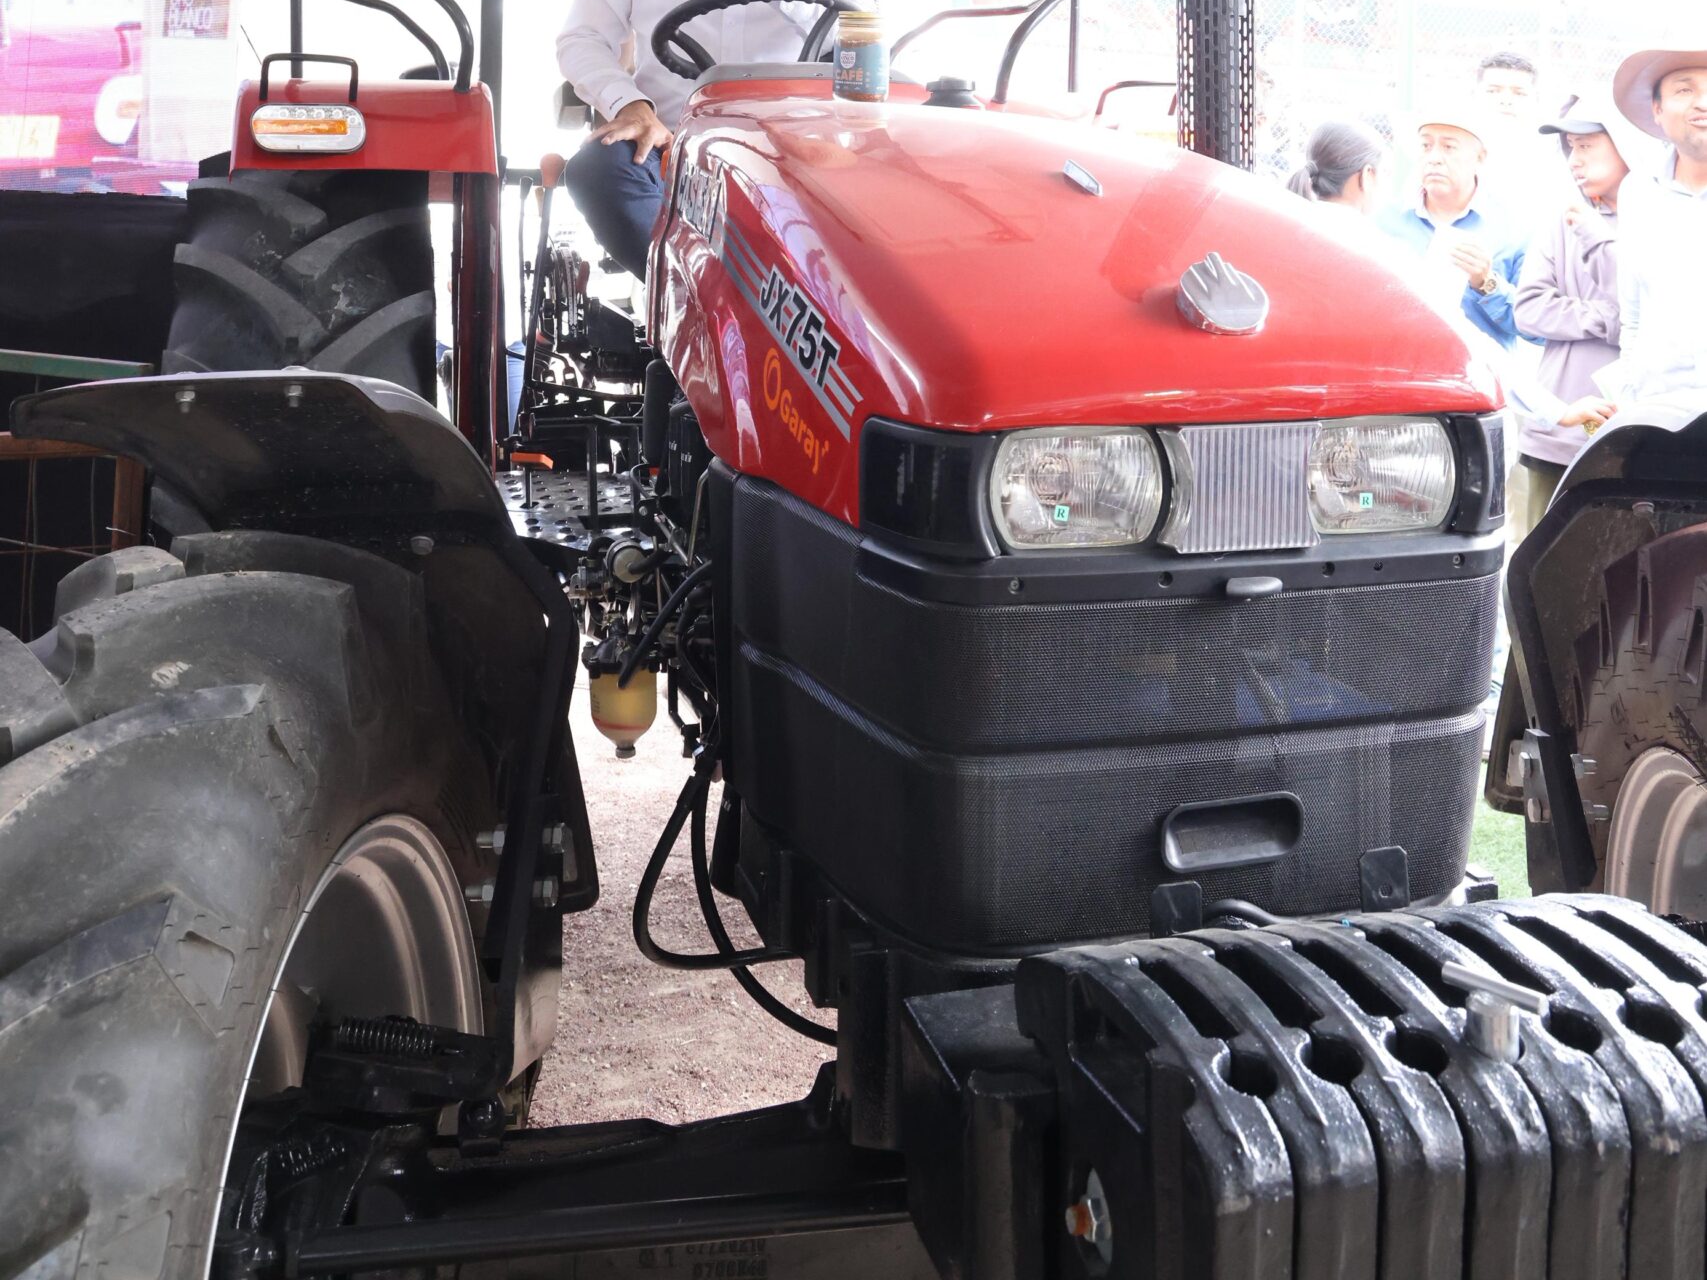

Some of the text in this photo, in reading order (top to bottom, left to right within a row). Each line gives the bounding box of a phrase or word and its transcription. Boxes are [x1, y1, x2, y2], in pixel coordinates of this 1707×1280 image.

[835, 67, 863, 81] CAFÉ
[760, 268, 839, 389] JX75T
[1362, 497, 1370, 506] R
[1057, 508, 1066, 519] R
